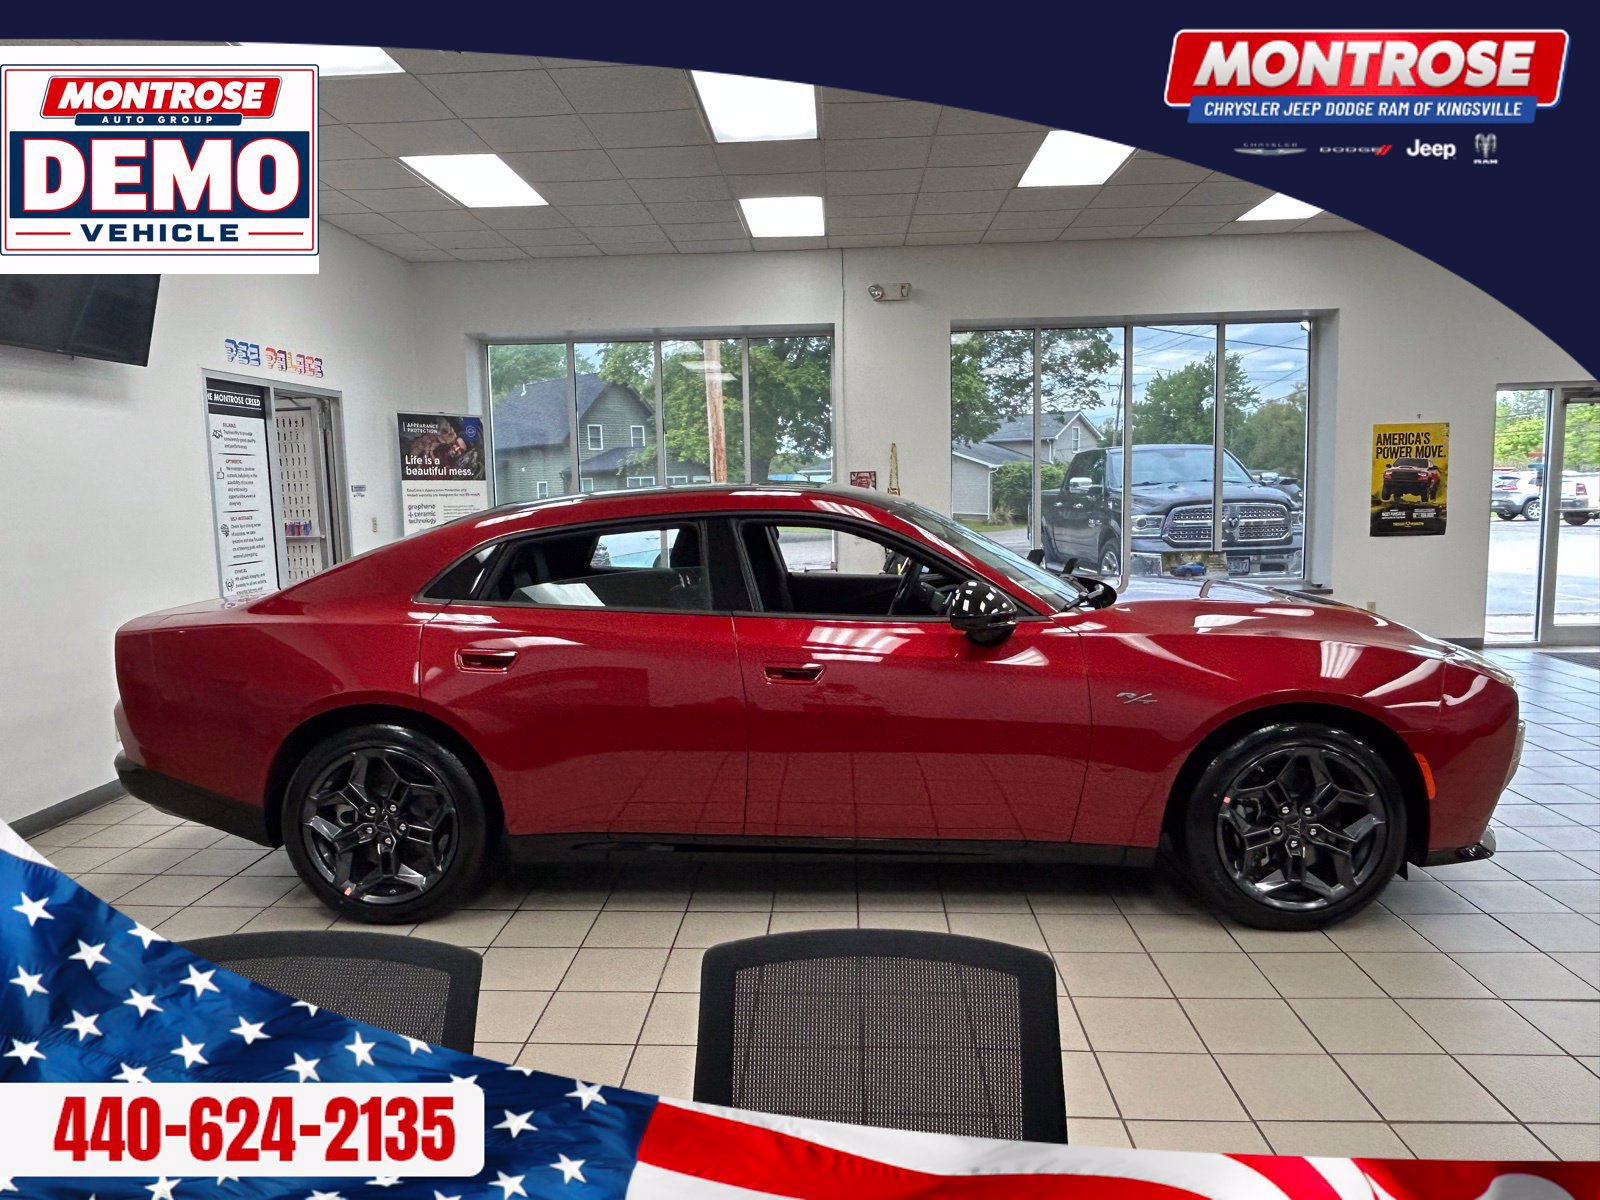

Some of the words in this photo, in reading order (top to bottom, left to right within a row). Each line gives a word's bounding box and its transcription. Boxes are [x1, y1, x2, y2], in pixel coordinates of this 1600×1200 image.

[213, 393, 244, 405] MONTROSE
[1376, 432, 1430, 446] AMERICA'S
[1376, 446, 1412, 459] POWER
[1415, 445, 1446, 459] MOVE.
[405, 455, 422, 465] Life
[425, 455, 432, 465] is
[434, 457, 440, 465] a
[406, 466, 447, 476] beautiful
